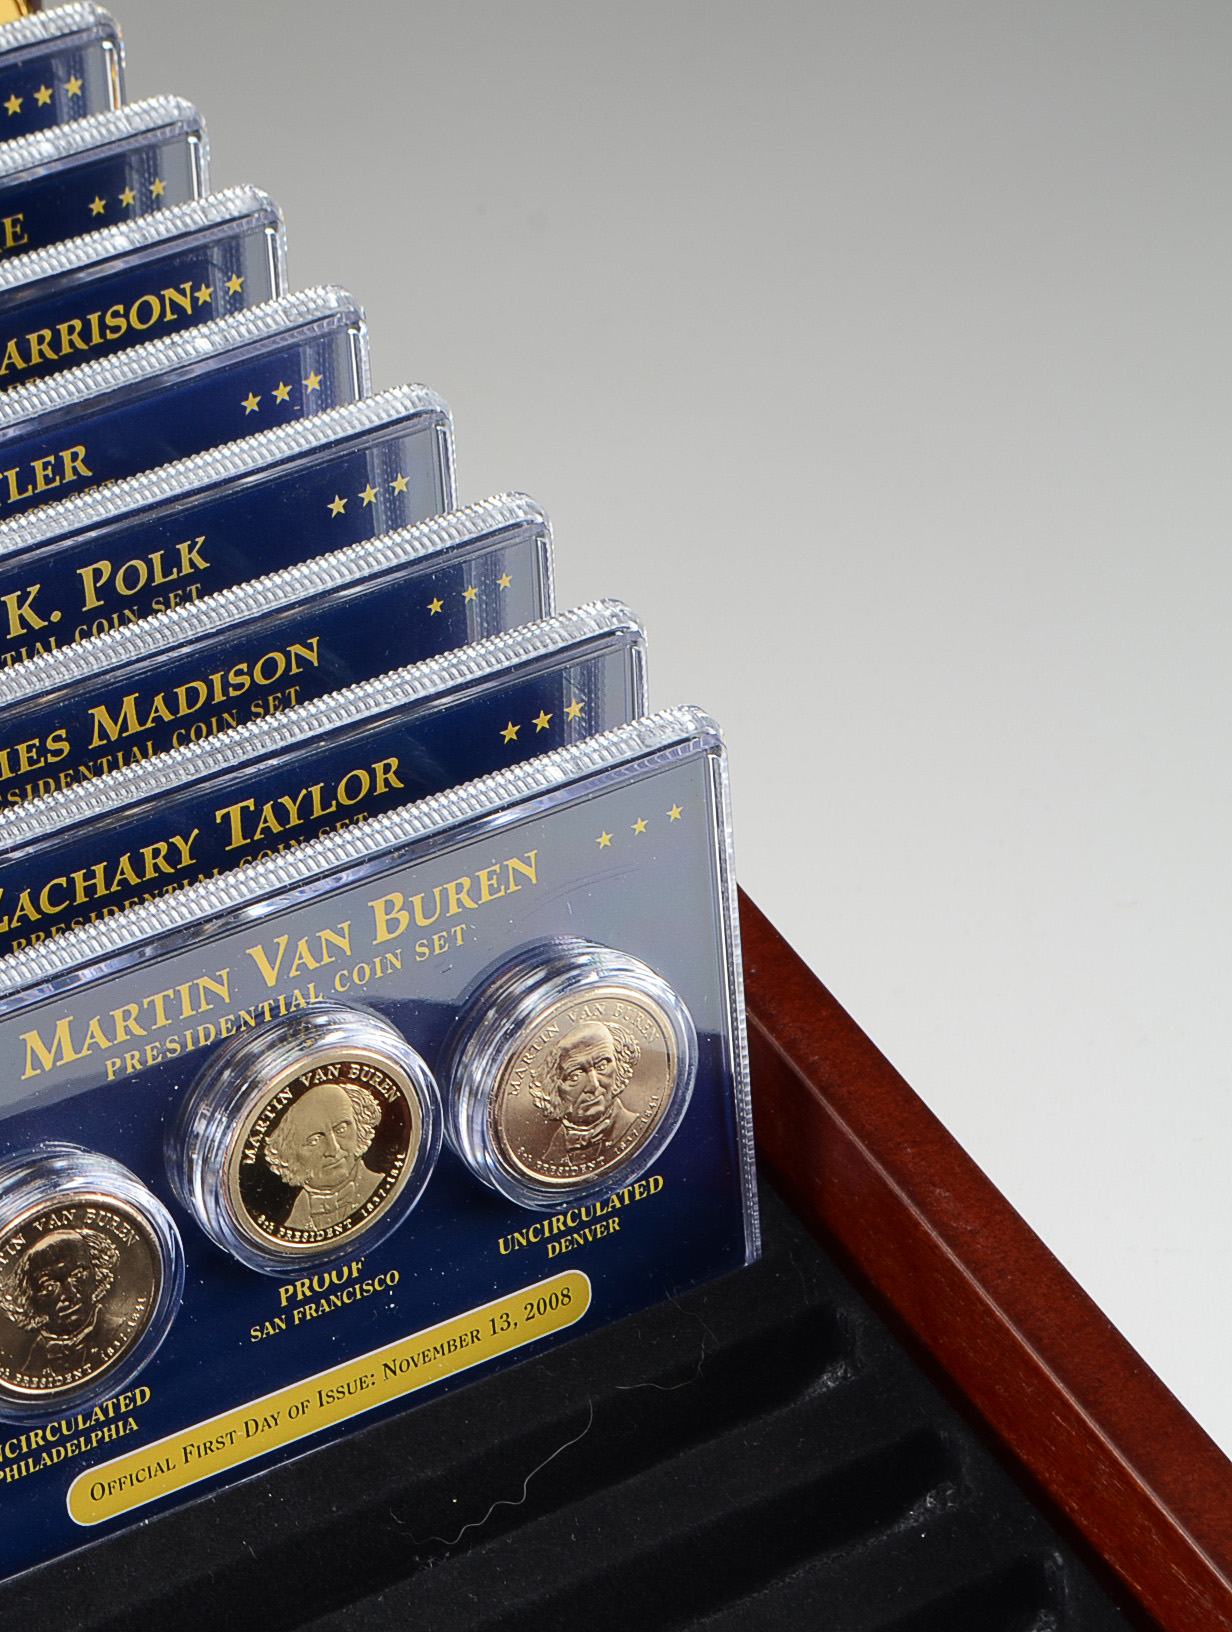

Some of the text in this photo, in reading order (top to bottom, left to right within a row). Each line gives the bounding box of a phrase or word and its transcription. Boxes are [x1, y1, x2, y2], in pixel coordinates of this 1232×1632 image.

[1, 584, 62, 640] K.
[77, 536, 211, 612] POLK
[88, 637, 321, 748] MADISON
[172, 709, 238, 749] COIN
[250, 686, 300, 720] SET
[215, 757, 405, 851] TAYLOR
[19, 850, 539, 1081] MARTIN VAN BUREN
[105, 924, 468, 1081] PRESIDENTIAL COIN SET
[242, 1064, 401, 1165] MARTIN VAN BUREN
[33, 1209, 76, 1231] VAN
[277, 1218, 353, 1243] PRESIDENT
[497, 1175, 664, 1256] UNCIRCULATED
[546, 1217, 621, 1259] DENVER
[250, 1270, 400, 1343] SAN FRANCISCO
[278, 1257, 366, 1308] PROOF
[90, 1456, 176, 1503] OFFICIAL
[182, 1428, 238, 1467] FIRST
[244, 1412, 281, 1440] DAY
[287, 1399, 311, 1421] OF
[381, 1328, 482, 1382] NOVEMBER
[488, 1312, 519, 1338] 13,
[524, 1287, 573, 1324] 2008
